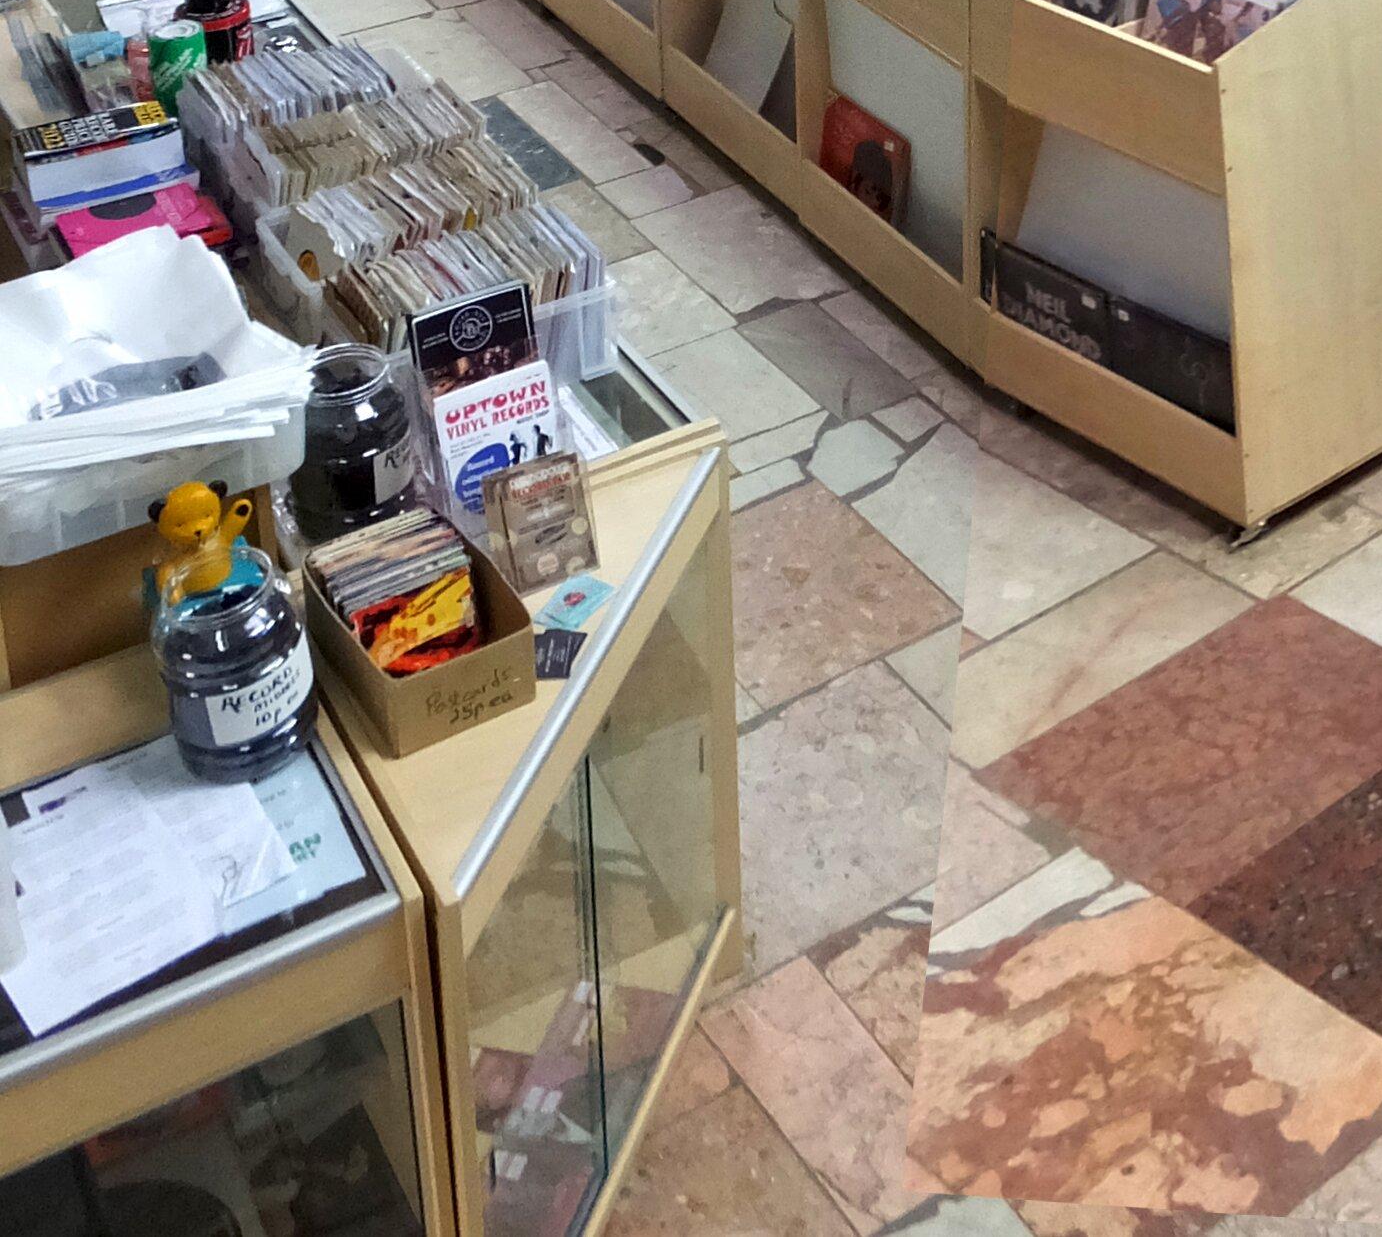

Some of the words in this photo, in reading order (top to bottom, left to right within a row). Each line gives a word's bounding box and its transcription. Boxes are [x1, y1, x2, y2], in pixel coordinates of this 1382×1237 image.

[1025, 282, 1067, 315] NEIL
[444, 381, 546, 424] UPTOWN
[447, 414, 487, 441] VINYL
[492, 395, 550, 426] RECORDS
